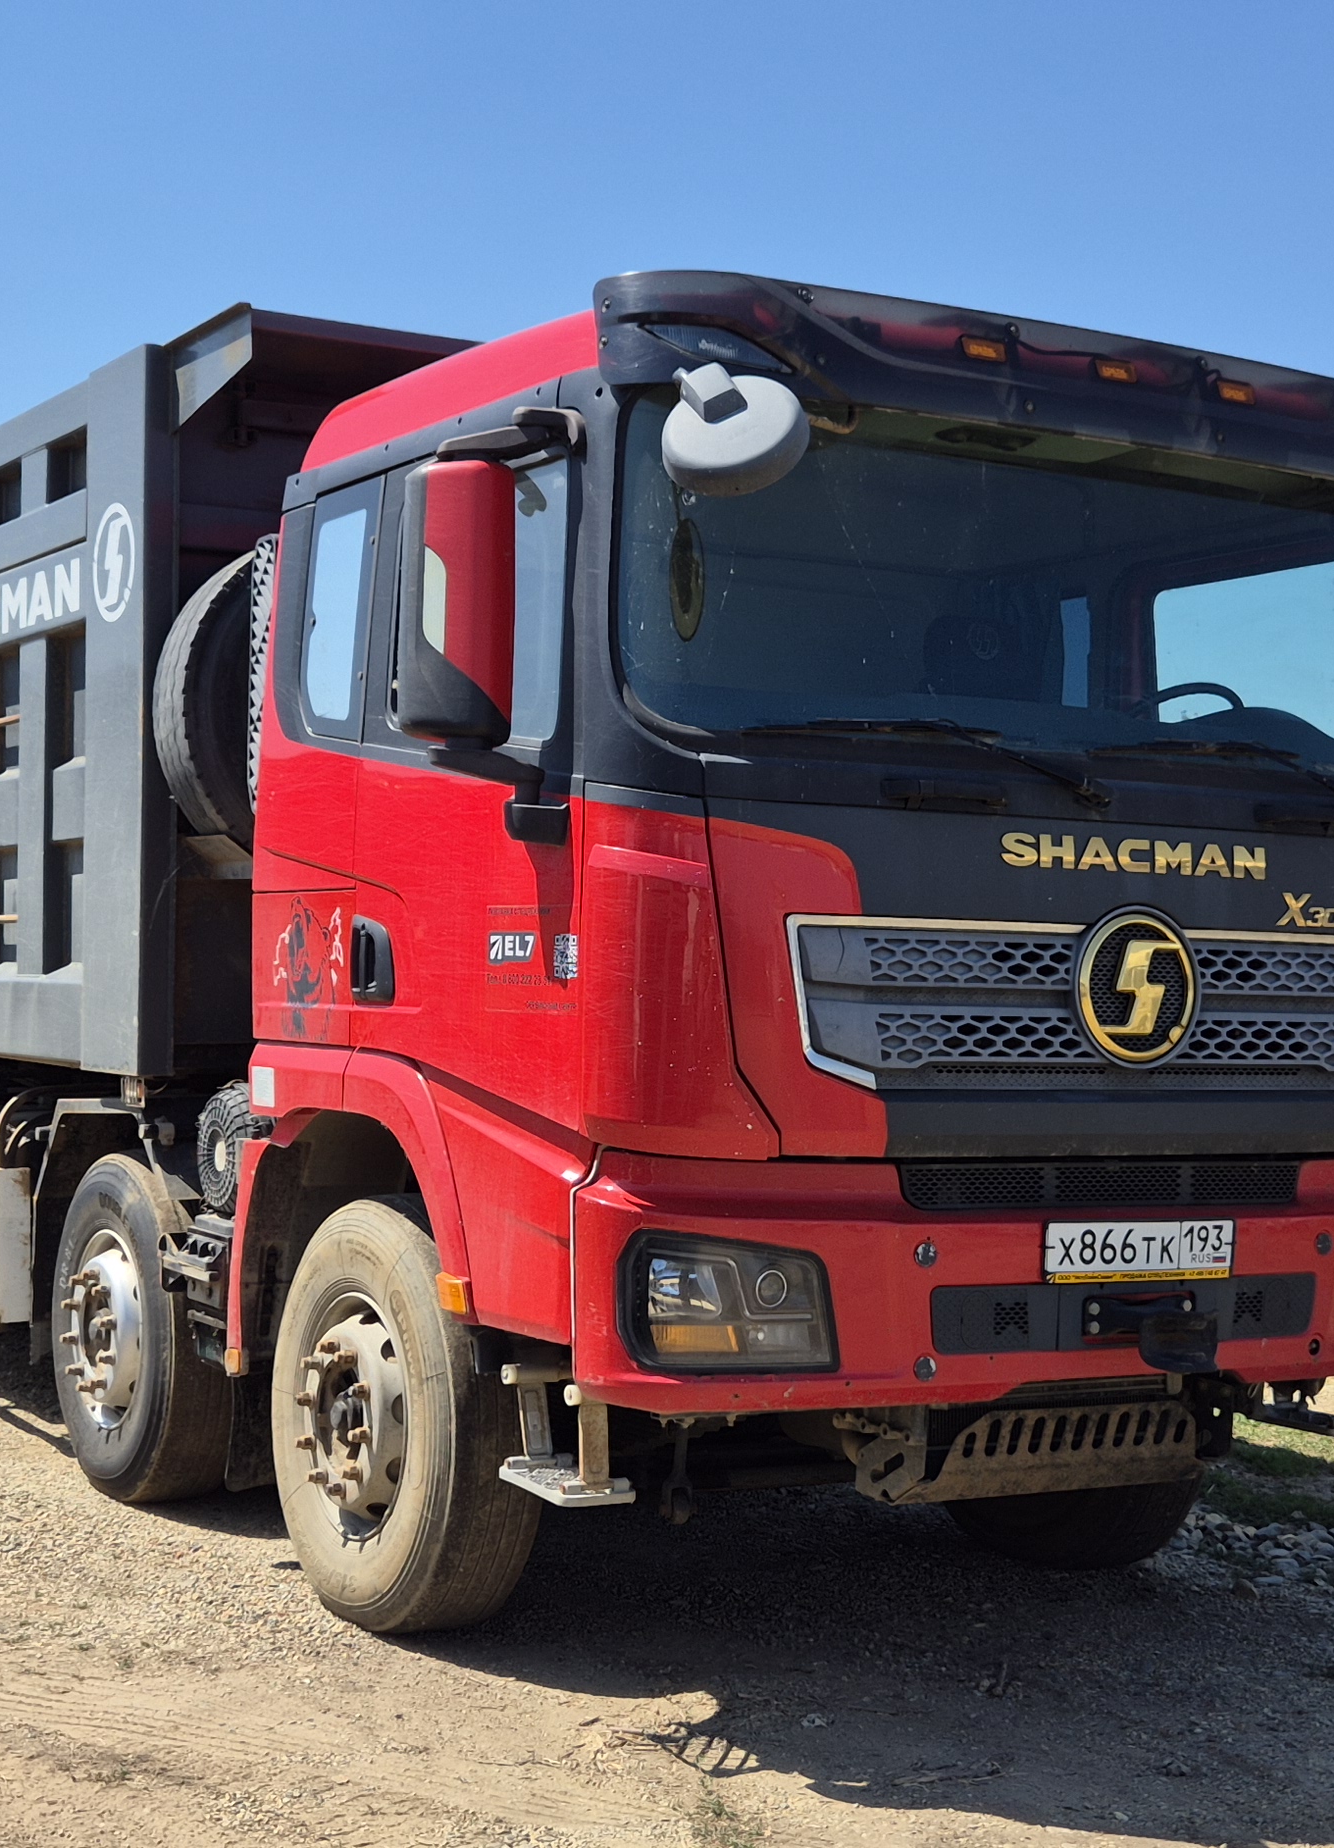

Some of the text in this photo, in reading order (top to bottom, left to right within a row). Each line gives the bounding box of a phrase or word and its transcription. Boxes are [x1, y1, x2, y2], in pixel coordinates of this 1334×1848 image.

[1000, 832, 1267, 880] SHACMAN
[1058, 1224, 1224, 1266] Х866ТК 193
[1191, 1253, 1211, 1264] RUS
